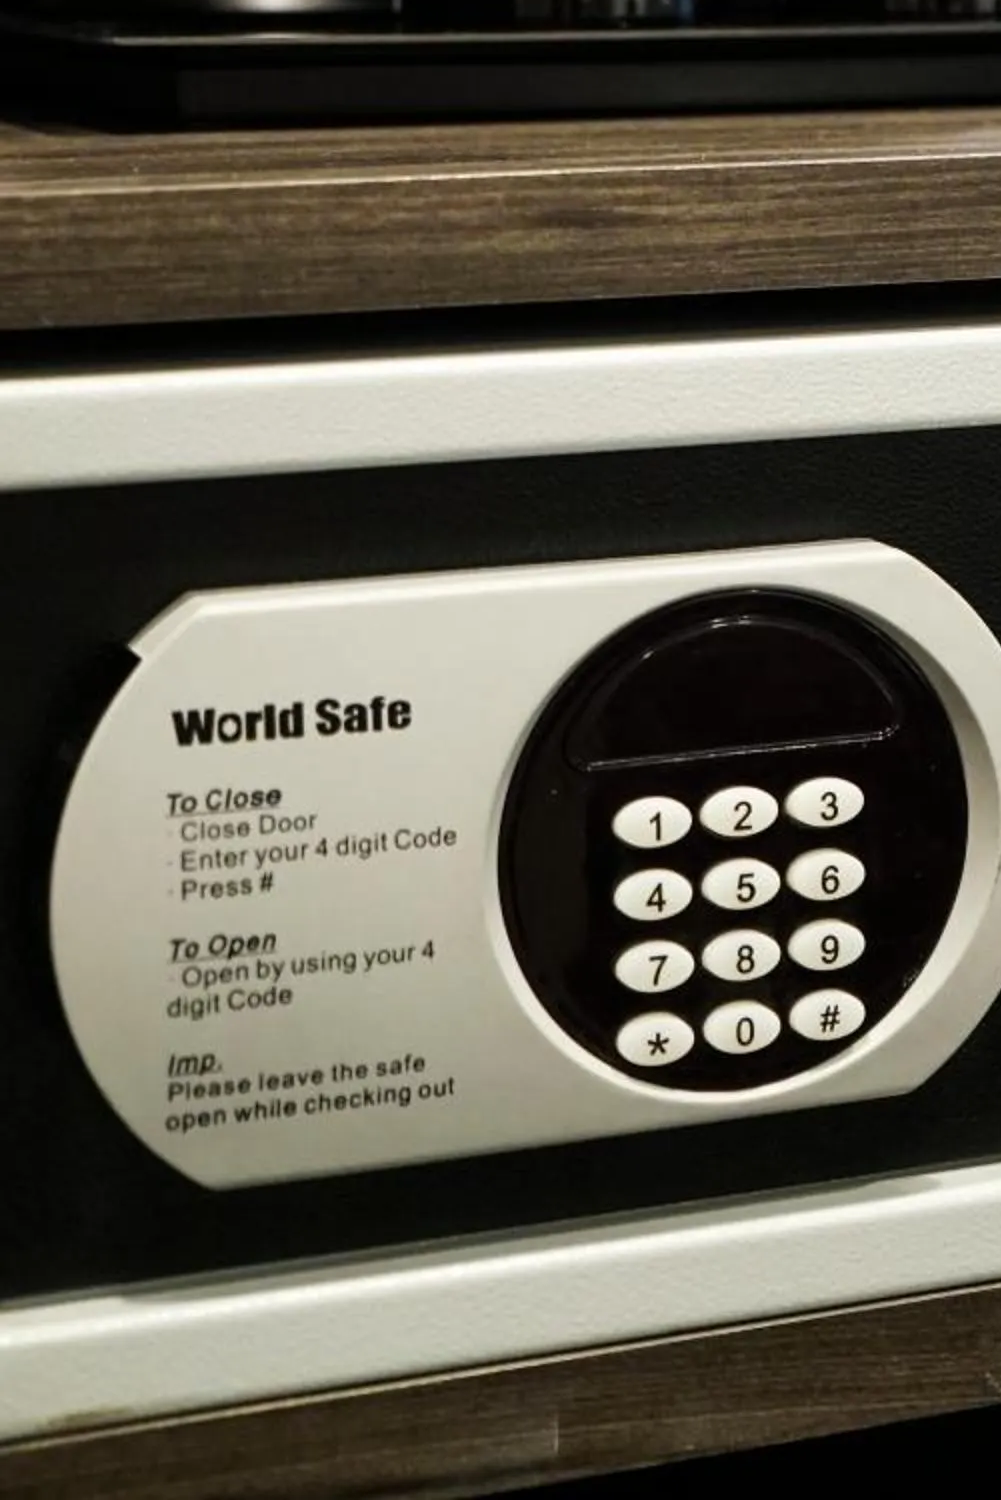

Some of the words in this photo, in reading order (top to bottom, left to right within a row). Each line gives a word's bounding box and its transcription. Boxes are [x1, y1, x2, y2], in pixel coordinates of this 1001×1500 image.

[172, 702, 305, 746] World
[315, 696, 412, 736] Safe
[167, 792, 197, 817] To
[205, 787, 283, 811] Close
[649, 812, 662, 841] 1
[733, 801, 752, 831] 2
[820, 791, 838, 821] 3
[180, 820, 251, 843] Close
[258, 813, 317, 836] Door
[180, 847, 247, 872] Enter
[255, 843, 308, 869] your
[314, 839, 328, 857] 4
[335, 832, 388, 858] digit
[393, 827, 458, 851] Code
[181, 876, 253, 900] Press
[259, 873, 275, 891] #
[646, 883, 666, 912] 4
[737, 873, 755, 902] 5
[821, 865, 840, 894] 6
[168, 938, 200, 962] To
[207, 932, 277, 962] Open
[181, 964, 250, 989] Open
[255, 959, 284, 983] by
[290, 951, 357, 978] using
[362, 946, 415, 973] your
[420, 940, 435, 960] 4
[650, 955, 668, 986] 7
[736, 944, 755, 973] 8
[820, 935, 839, 964] 9
[166, 994, 222, 1021] digit
[226, 986, 293, 1012] Code
[736, 1017, 755, 1045] 0
[820, 1005, 840, 1033] #
[167, 1051, 223, 1080] Imp.
[167, 1076, 252, 1102] Please
[258, 1071, 325, 1093] leave
[331, 1062, 368, 1083] the
[375, 1054, 426, 1077] safe
[165, 1108, 227, 1134] open
[233, 1100, 298, 1124] while
[303, 1085, 412, 1114] checking
[417, 1078, 456, 1099] out
